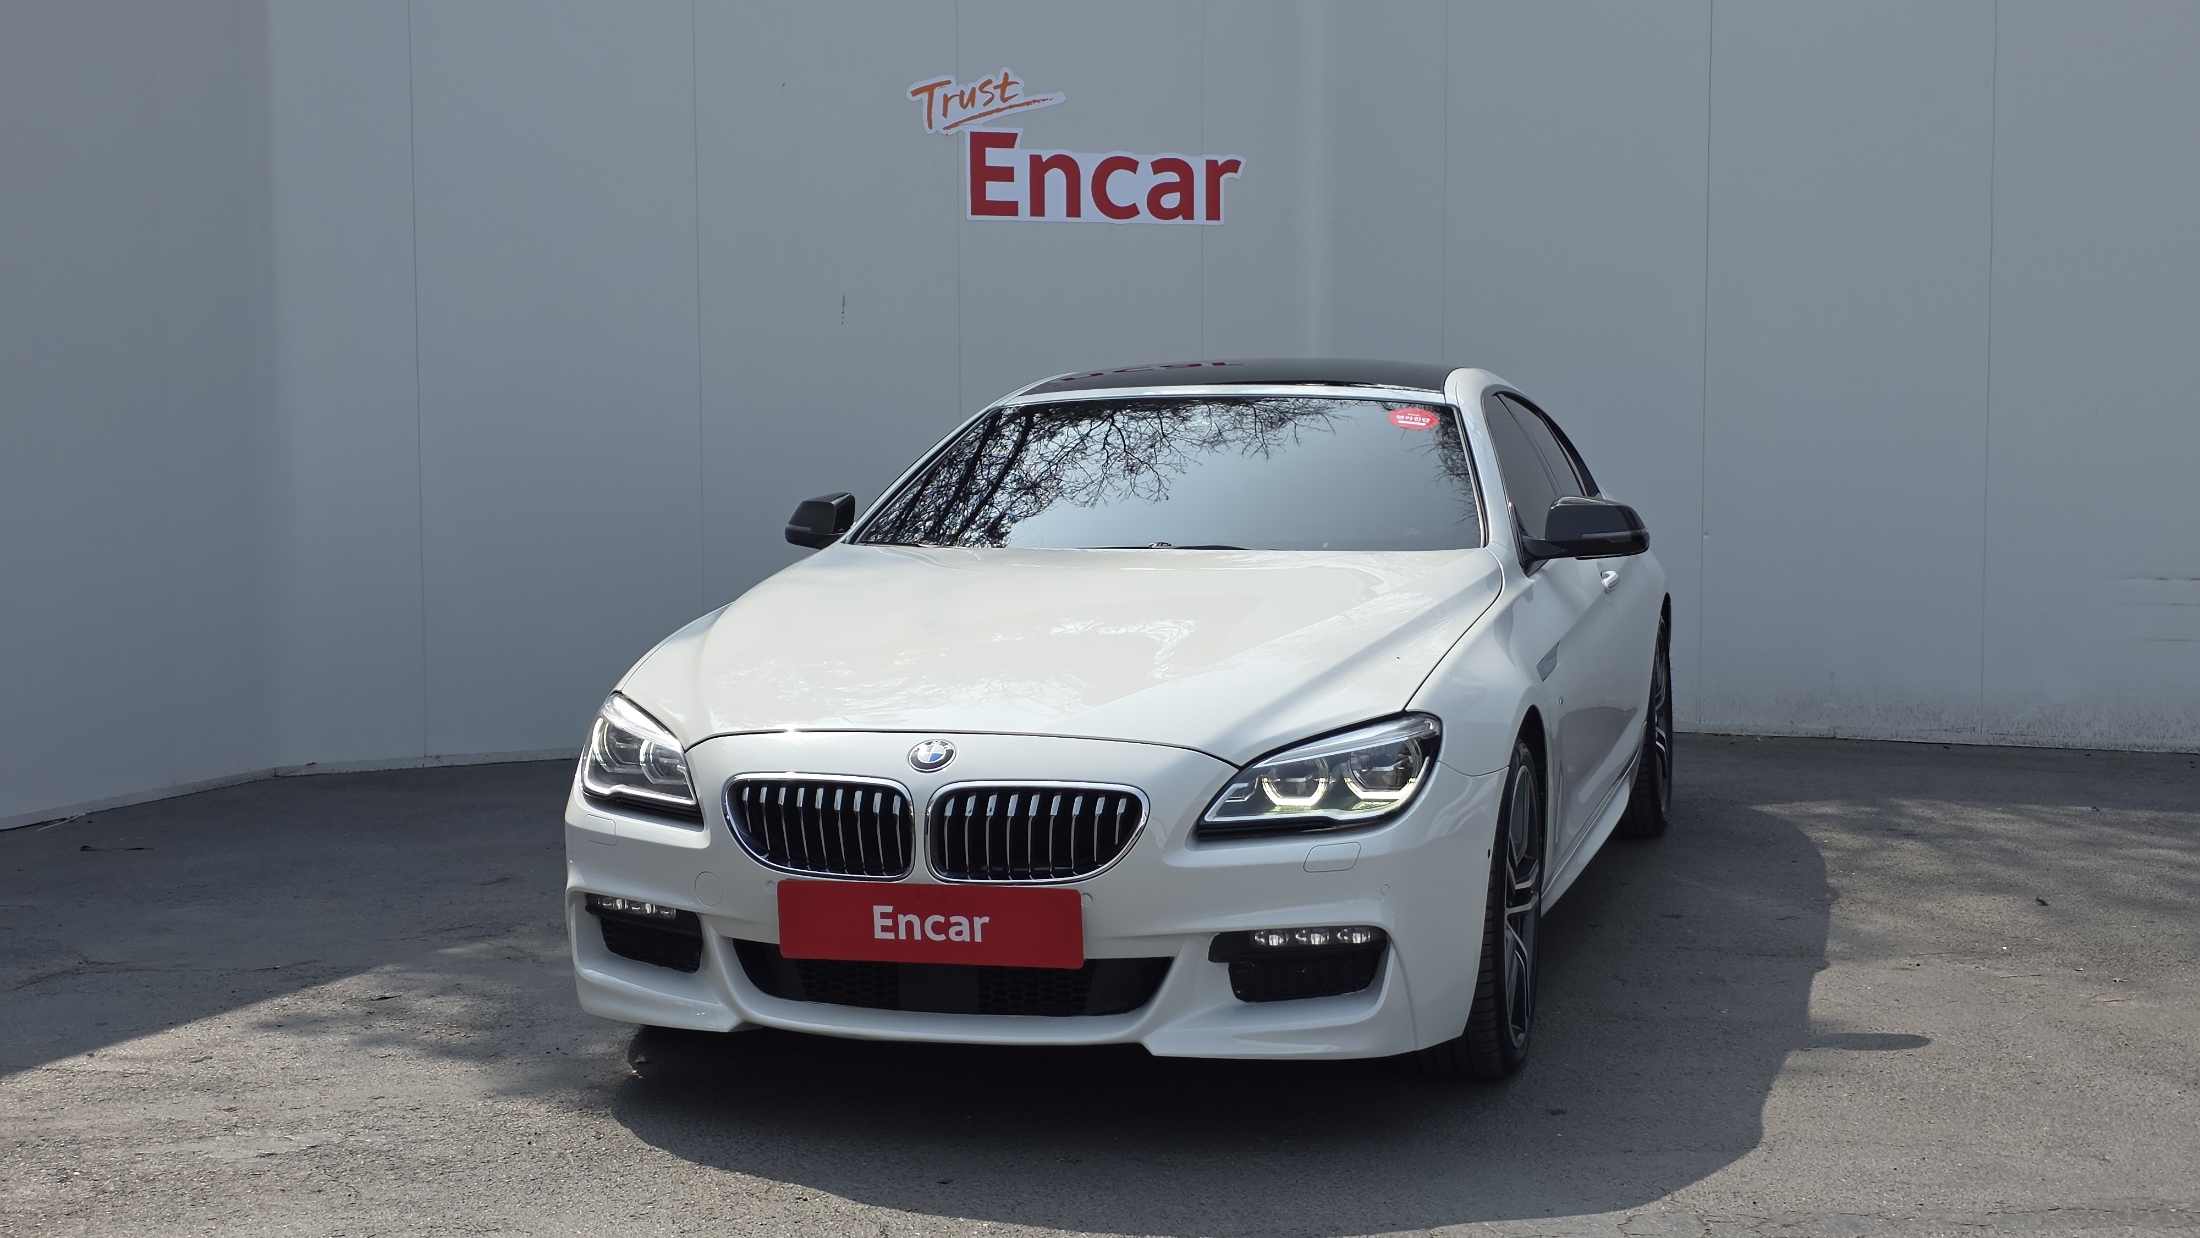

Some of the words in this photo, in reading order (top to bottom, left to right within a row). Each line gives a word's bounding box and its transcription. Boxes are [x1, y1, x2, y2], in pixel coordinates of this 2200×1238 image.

[910, 71, 1020, 130] Trust
[969, 130, 1242, 221] Encar
[872, 904, 990, 943] Encar
